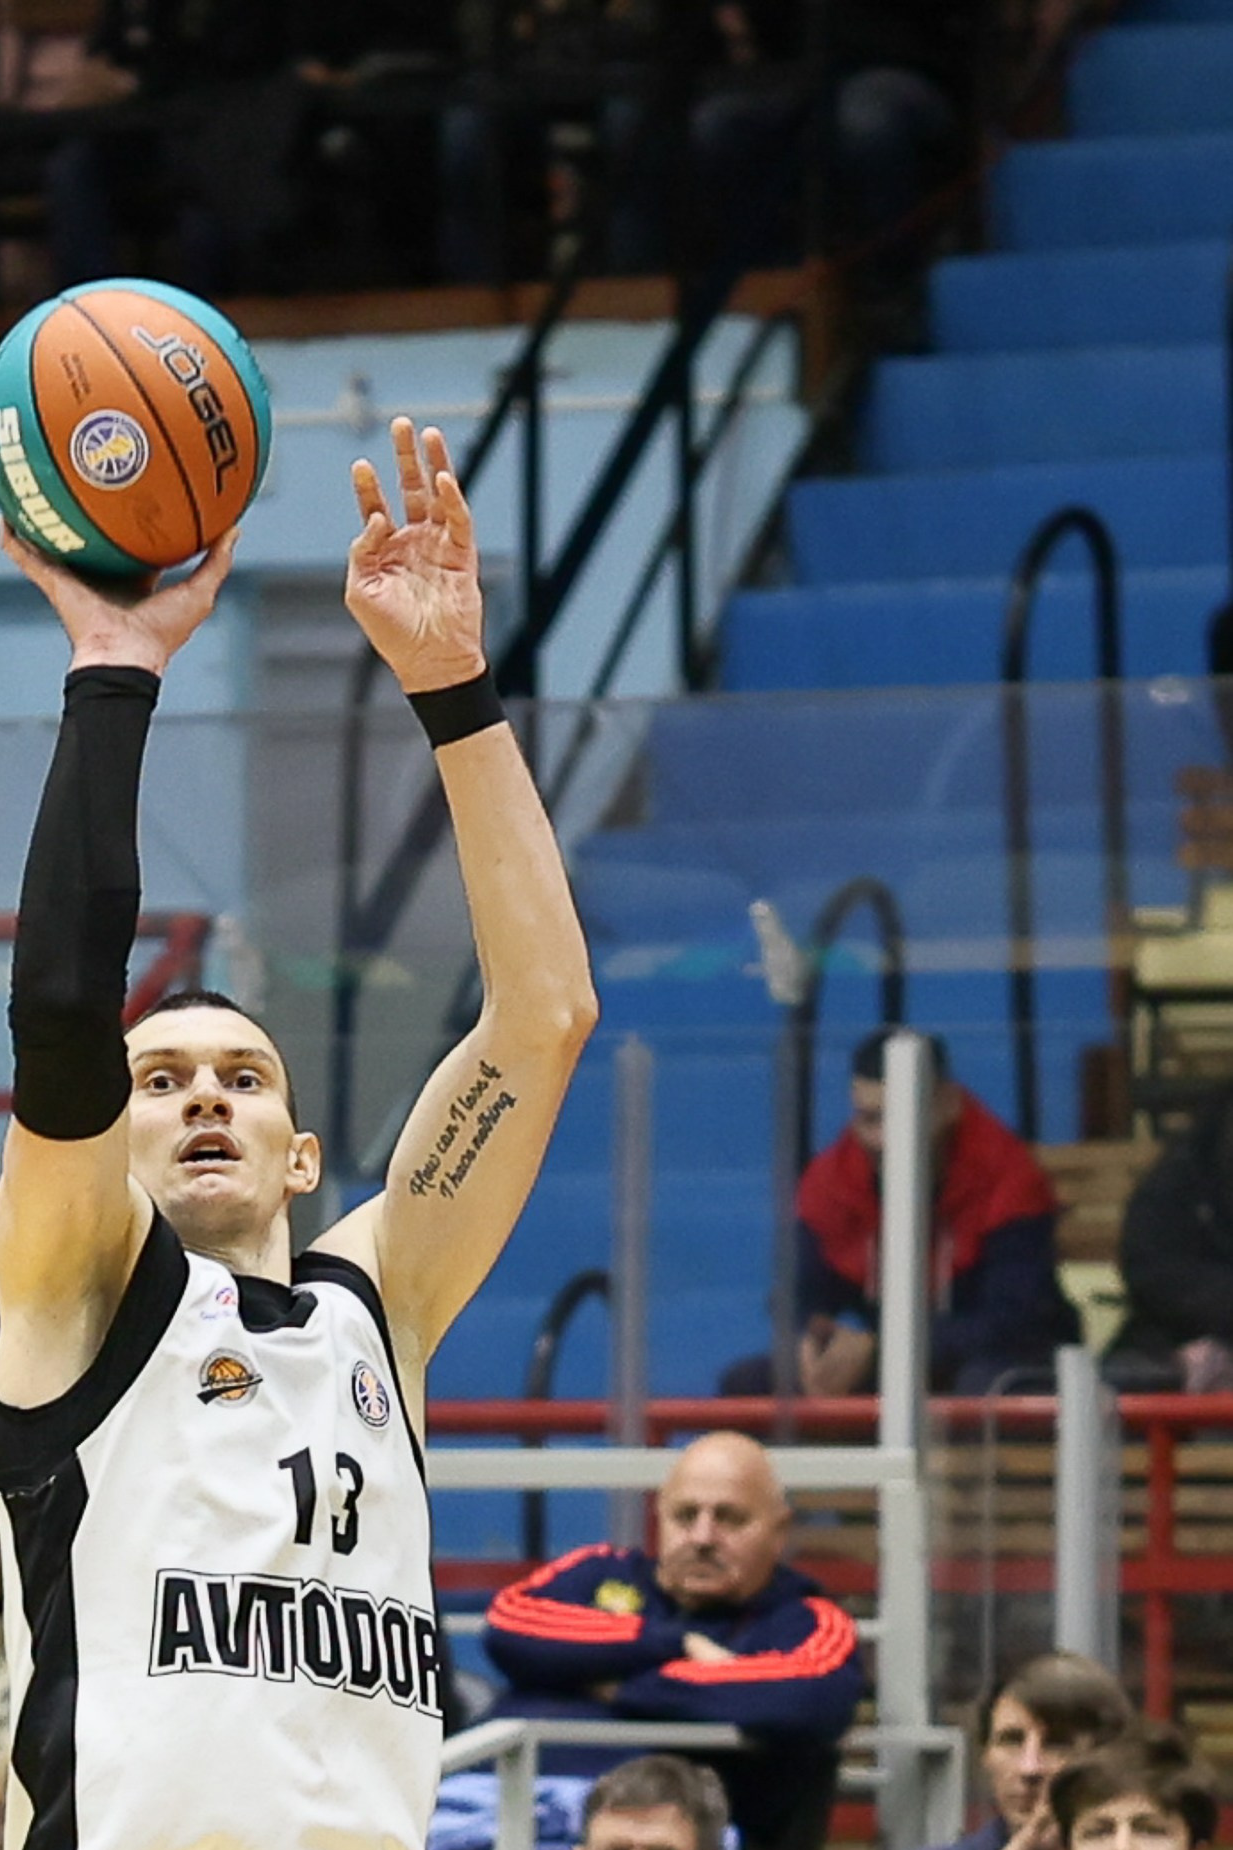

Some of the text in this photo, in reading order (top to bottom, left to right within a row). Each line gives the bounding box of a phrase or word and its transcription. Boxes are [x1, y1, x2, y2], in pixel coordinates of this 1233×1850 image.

[472, 1091, 517, 1151] nothing
[409, 1154, 441, 1196] How
[436, 1124, 459, 1154] can
[278, 1446, 364, 1556] 13
